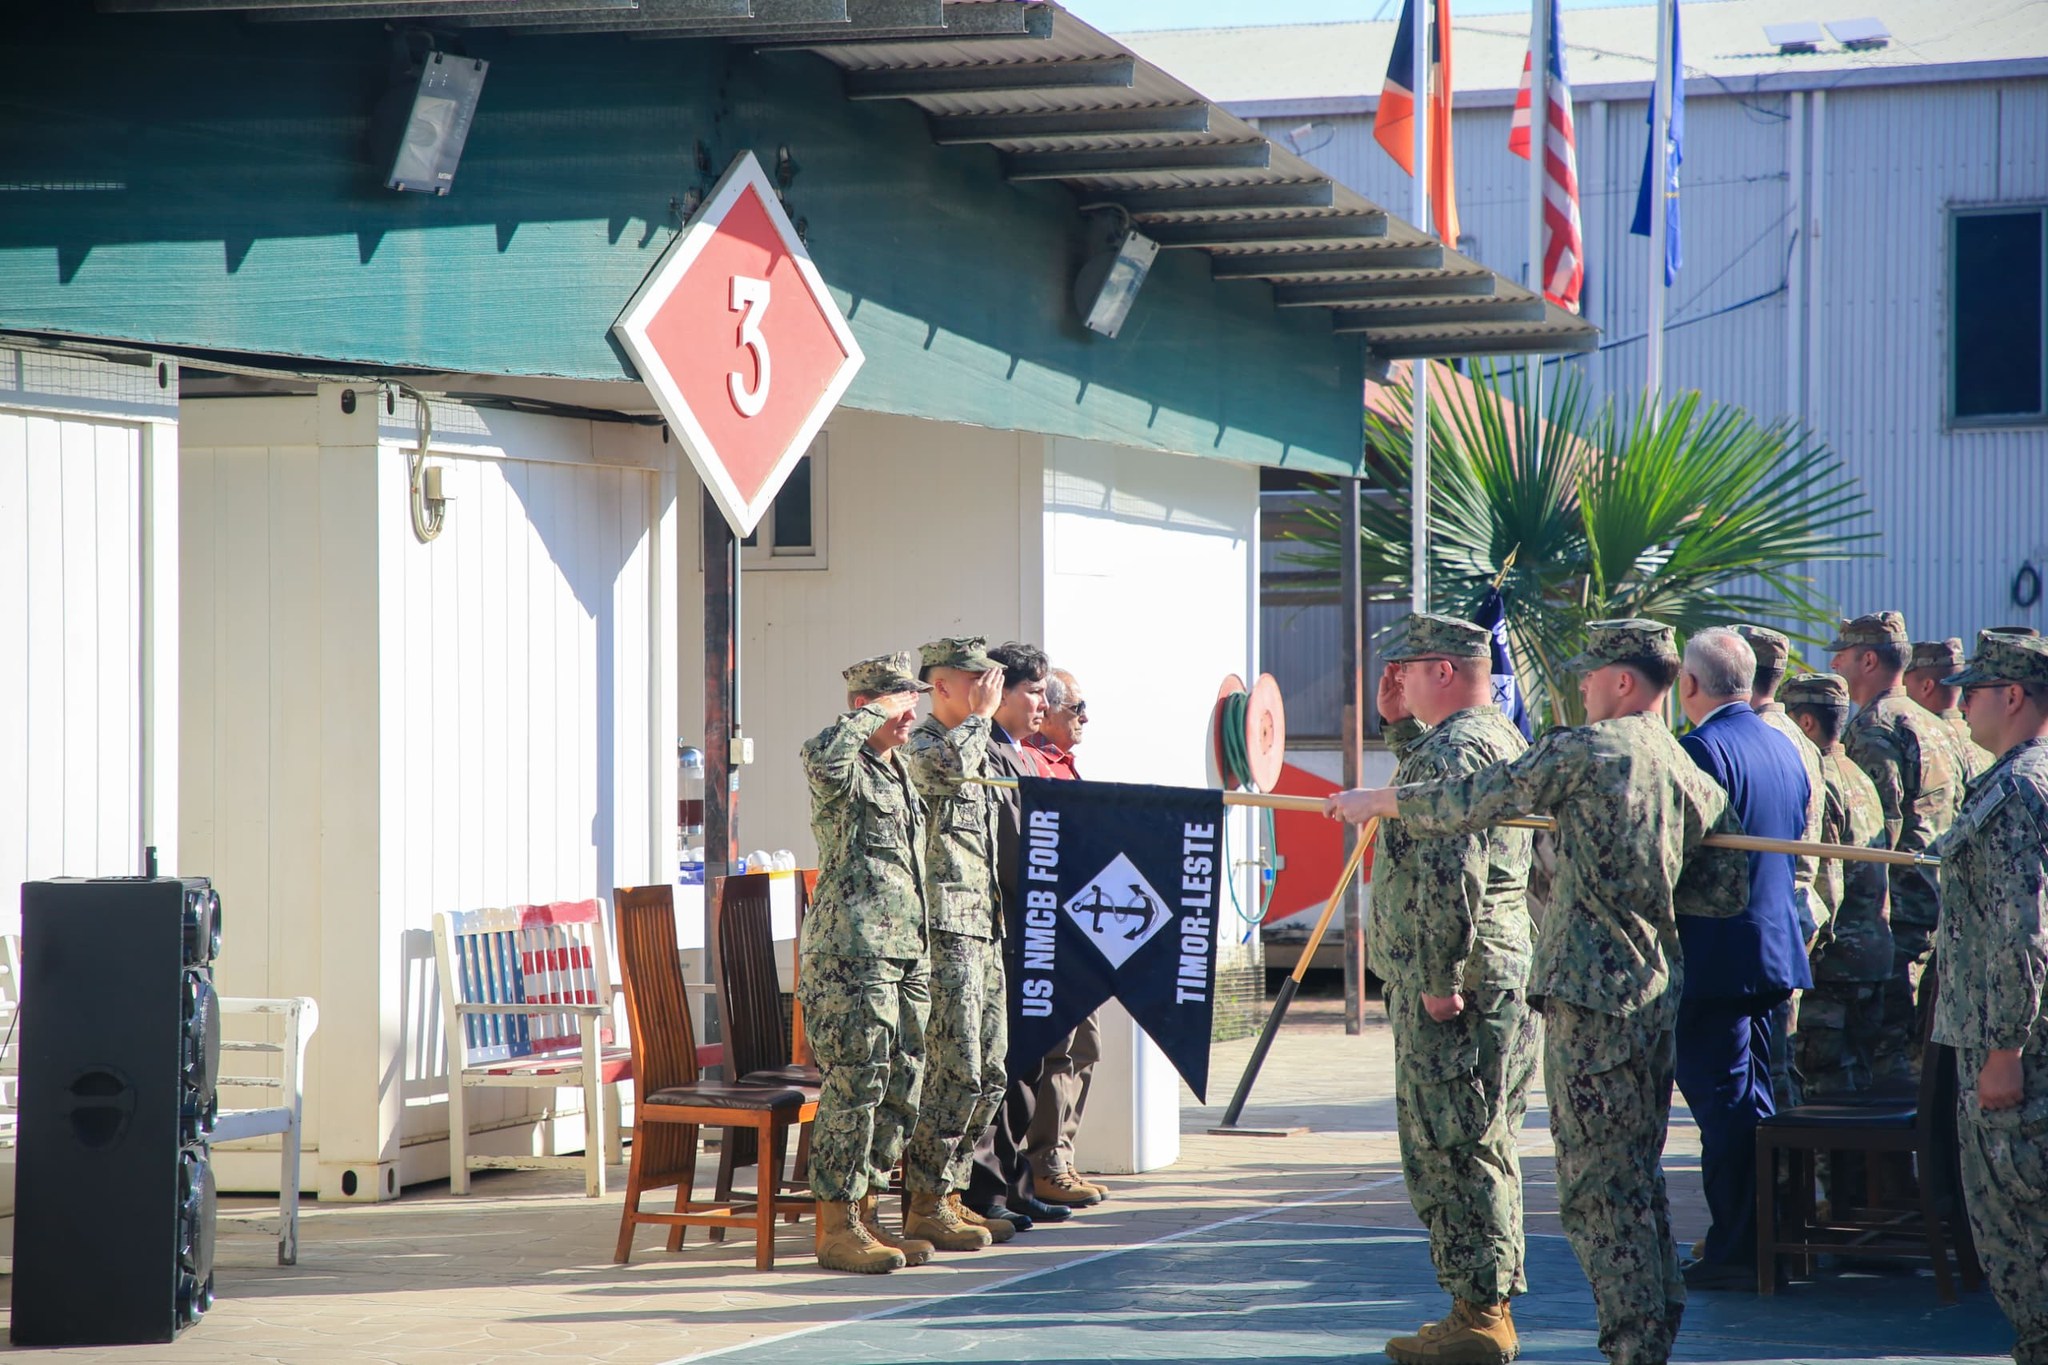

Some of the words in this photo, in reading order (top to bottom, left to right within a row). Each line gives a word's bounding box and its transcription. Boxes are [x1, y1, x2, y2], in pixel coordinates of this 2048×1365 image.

[728, 275, 771, 418] 3
[1028, 810, 1060, 882] FOUR
[1024, 890, 1058, 971] NMCB
[1176, 822, 1215, 1005] TIMOR-LESTE
[1022, 979, 1054, 1017] US
